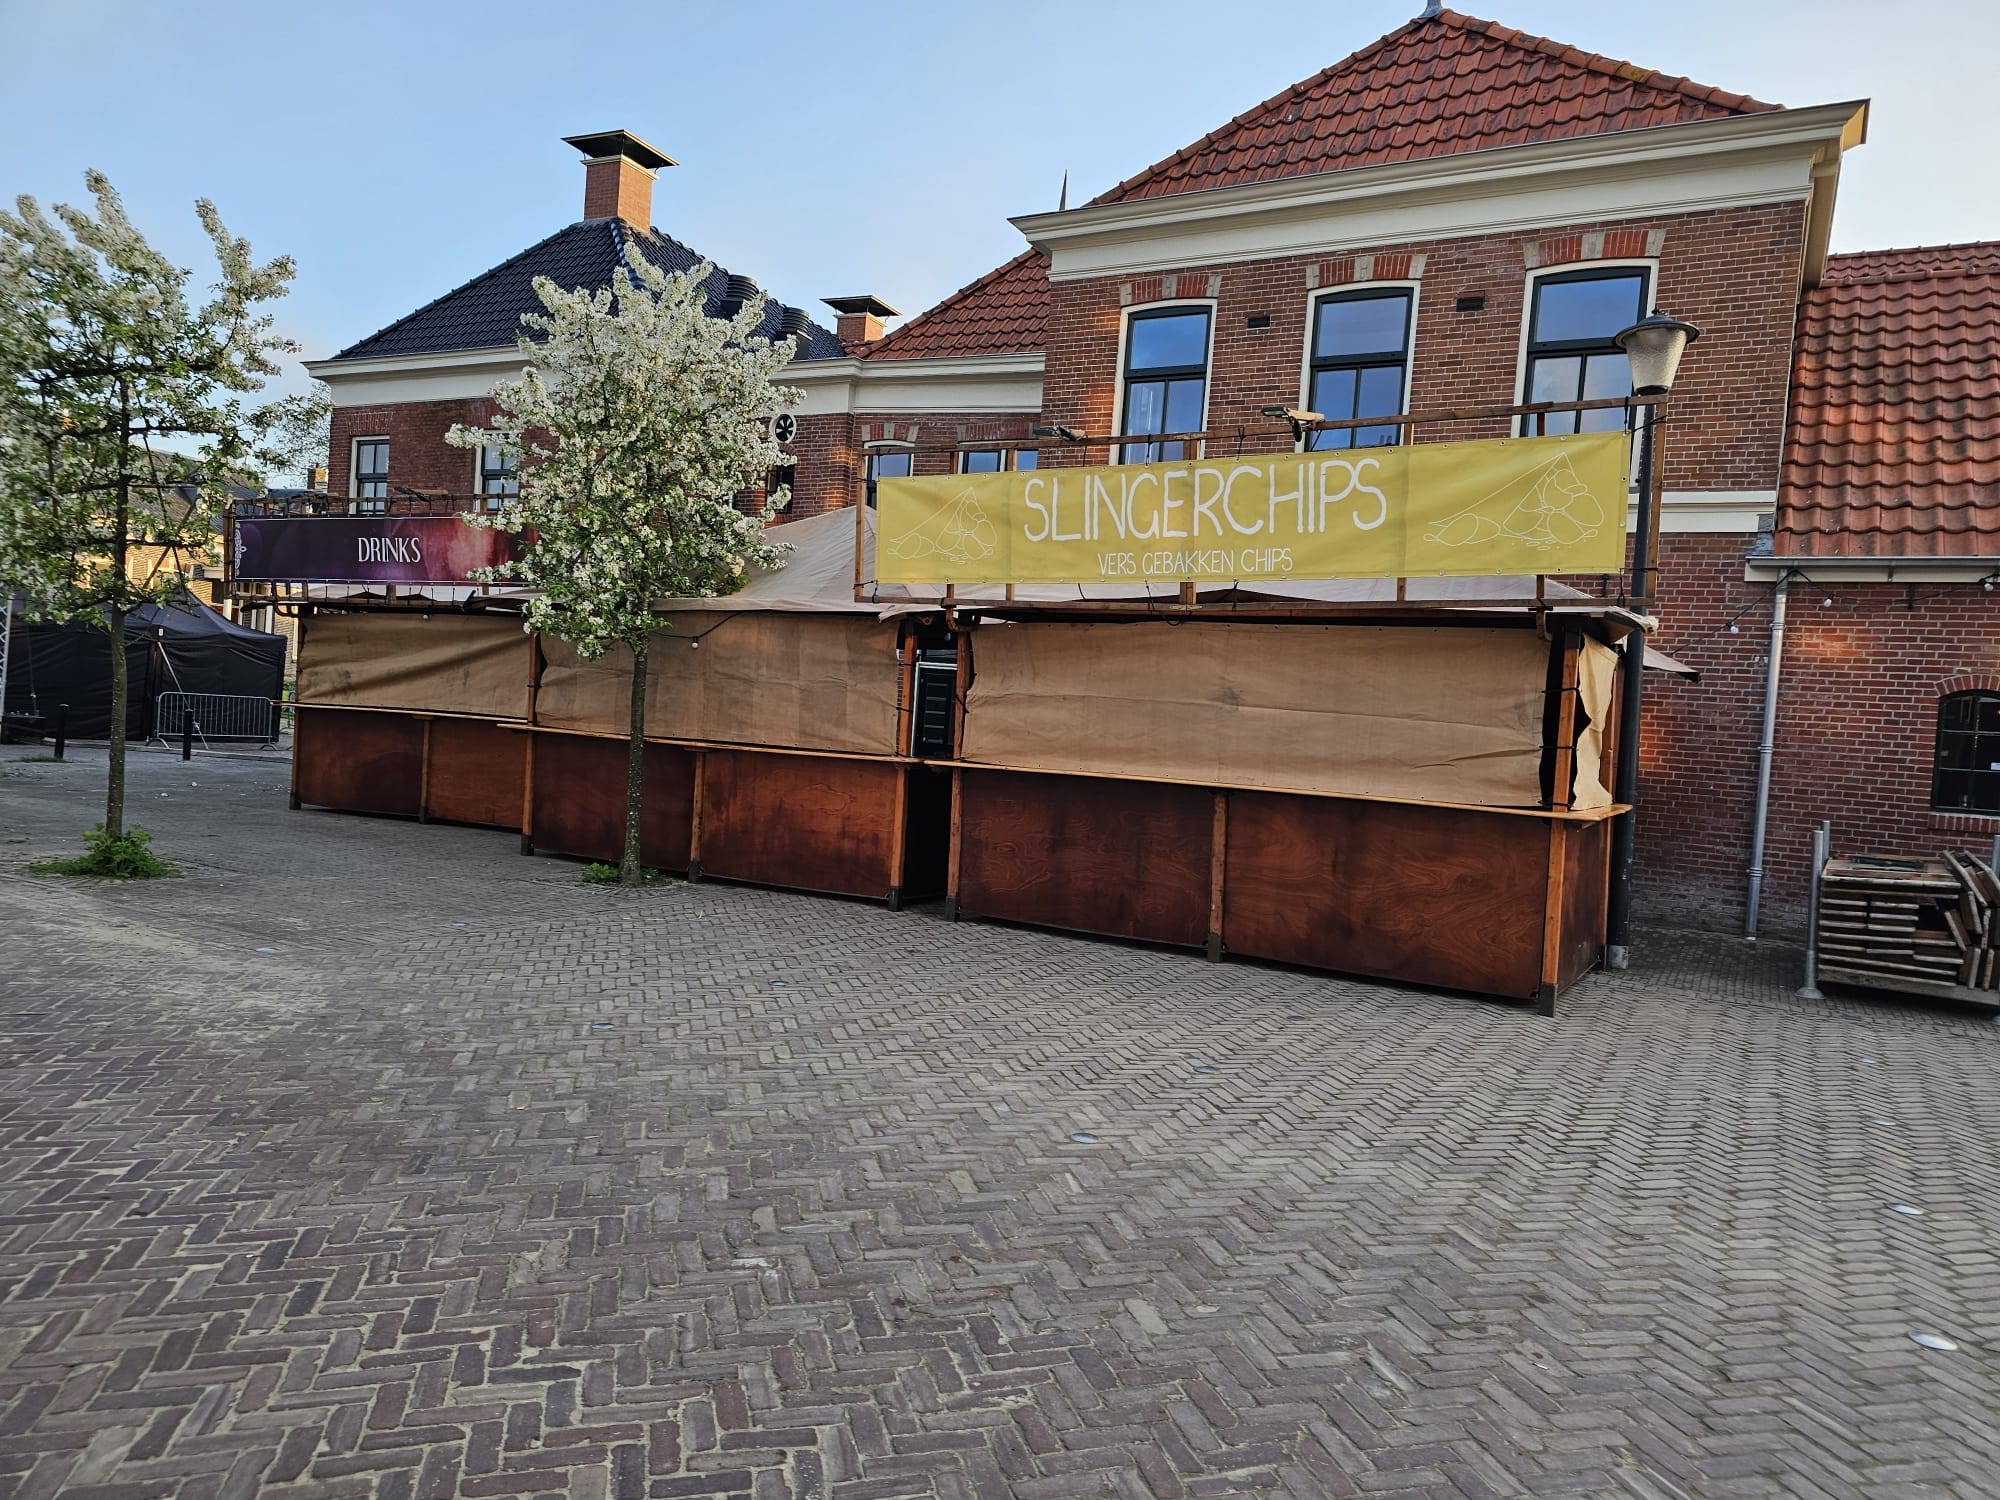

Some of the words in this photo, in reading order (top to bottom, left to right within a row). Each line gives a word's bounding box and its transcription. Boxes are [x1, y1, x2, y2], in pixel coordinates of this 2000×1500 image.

[1023, 457, 1387, 542] SLINGERCHIPS
[357, 537, 421, 563] DRINKS
[1097, 552, 1137, 576] VERS
[1141, 549, 1234, 575] GEBAKKEN
[1240, 547, 1293, 573] CHIPS
